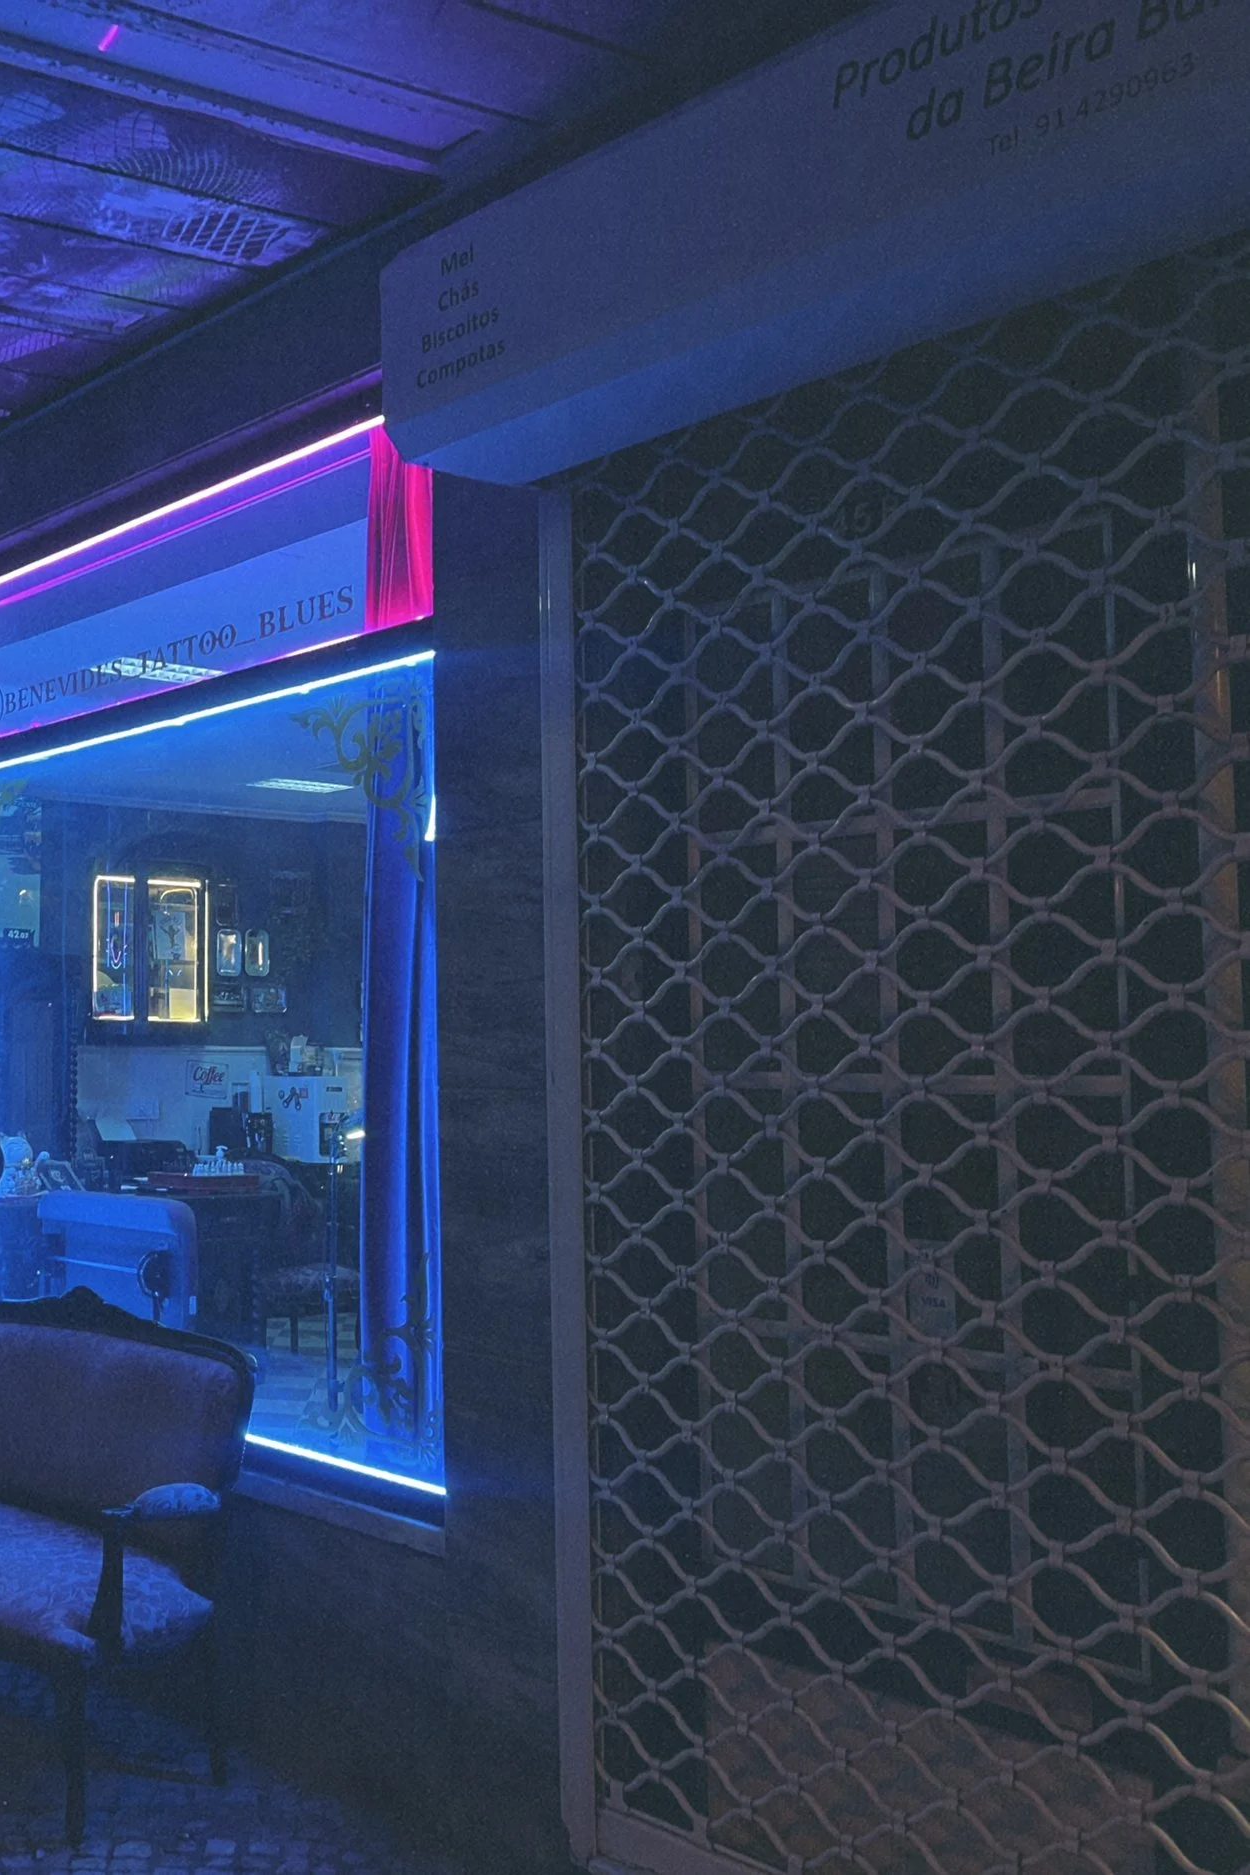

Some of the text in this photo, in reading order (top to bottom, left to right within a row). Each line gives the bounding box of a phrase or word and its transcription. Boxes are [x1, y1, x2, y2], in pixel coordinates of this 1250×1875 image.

[907, 87, 964, 140] da
[983, 18, 1115, 109] Beira
[440, 241, 474, 276] Mel
[438, 279, 479, 311] Chás
[421, 307, 499, 354] Biscoitos
[417, 339, 506, 389] Compotas
[193, 1065, 225, 1085] Coffee
[921, 1296, 946, 1309] VISA
